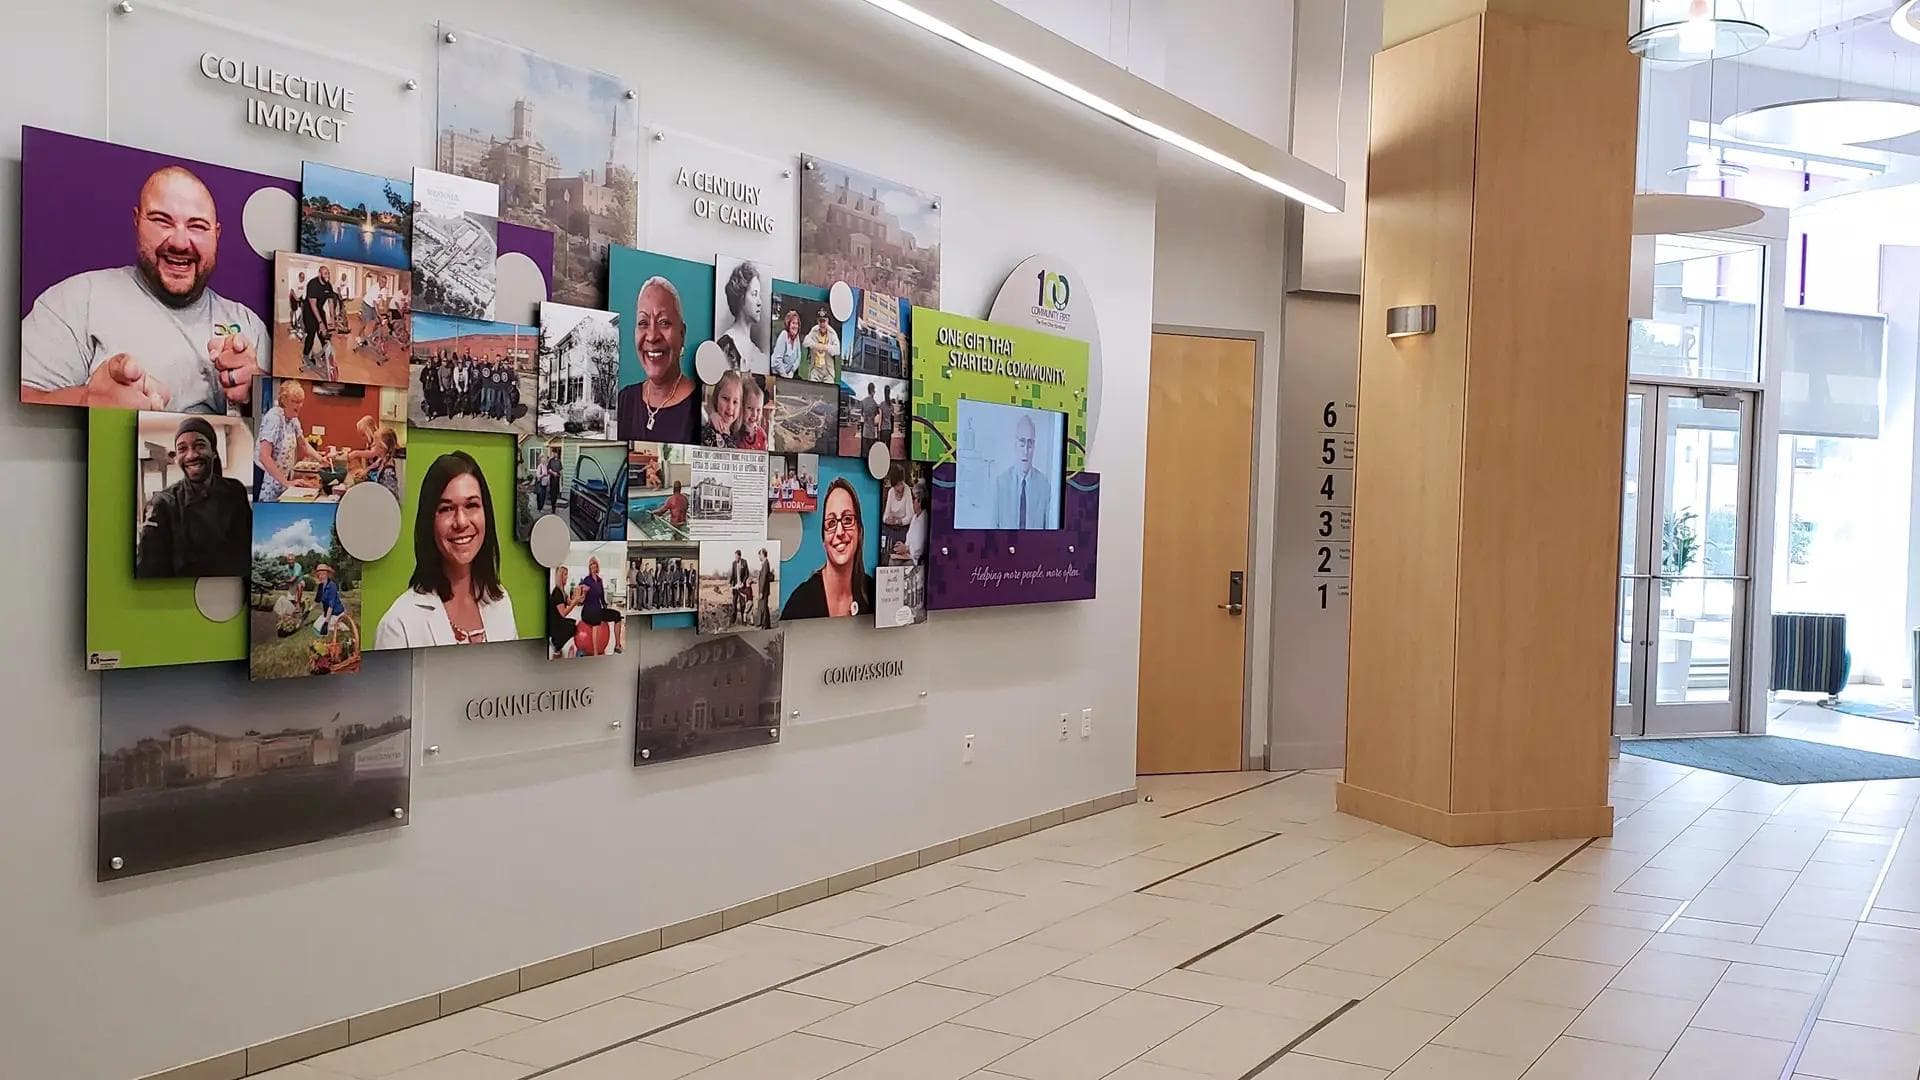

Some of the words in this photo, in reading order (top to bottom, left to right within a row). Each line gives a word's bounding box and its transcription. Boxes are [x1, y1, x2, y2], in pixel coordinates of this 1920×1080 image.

[200, 52, 355, 113] COLLECTIVE
[247, 98, 347, 143] IMPACT
[676, 166, 690, 188] A
[693, 171, 762, 206] CENTURY
[694, 197, 716, 219] OF
[719, 203, 775, 234] CARING
[1037, 269, 1070, 311] 100
[1031, 306, 1059, 321] COMMUNITY
[938, 327, 962, 346] ONE
[964, 332, 986, 351] GIFT
[989, 336, 1015, 356] THAT
[949, 350, 993, 373] STARTED
[996, 359, 1004, 375] A
[1006, 360, 1066, 385] COMMUNITY.
[1323, 401, 1337, 427] 6
[1322, 438, 1335, 464] 5
[1320, 474, 1334, 500] 4
[1319, 511, 1332, 537] 3
[1317, 546, 1331, 572] 2
[969, 565, 1002, 588] Helping
[1003, 570, 1021, 580] more
[1046, 568, 1062, 578] more
[1317, 583, 1327, 609] 1
[823, 660, 903, 686] COMPASSION
[466, 686, 594, 720] CONNECTING
